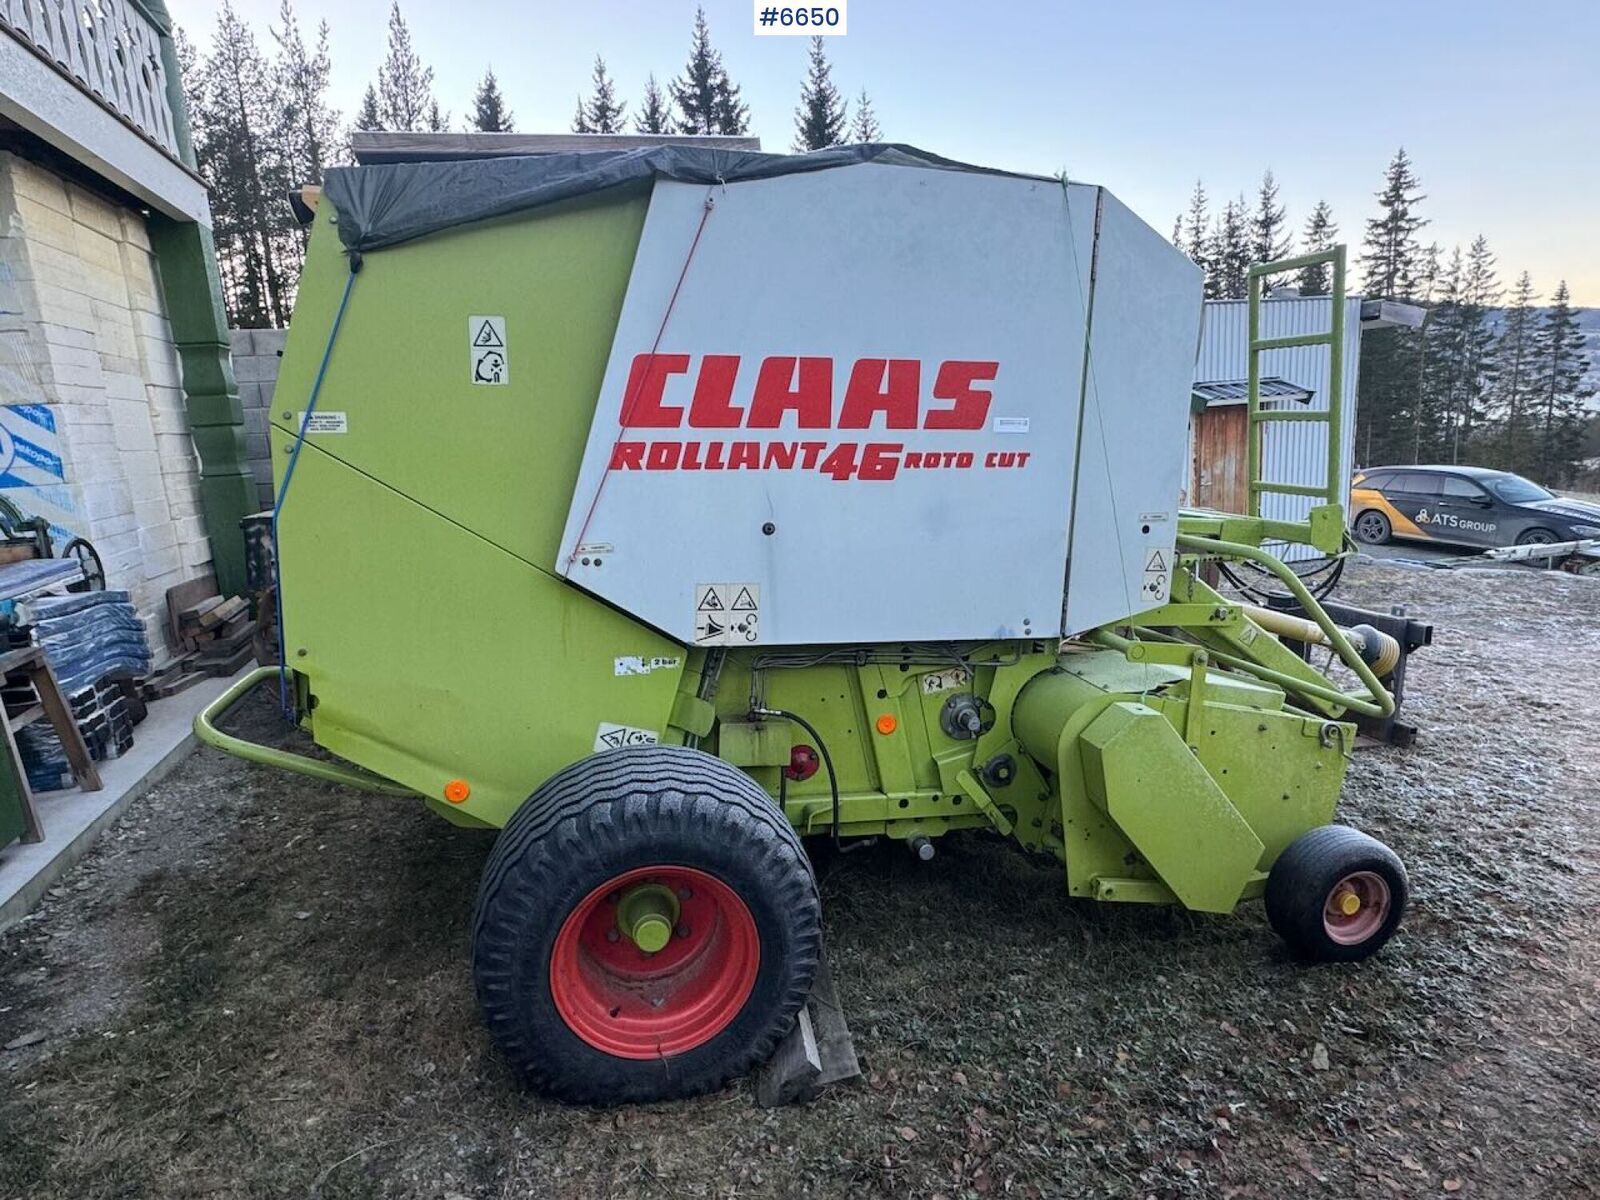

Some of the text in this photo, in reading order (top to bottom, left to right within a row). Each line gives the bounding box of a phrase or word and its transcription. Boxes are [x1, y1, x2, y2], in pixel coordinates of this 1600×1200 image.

[618, 353, 1000, 430] CLAAS
[608, 441, 1031, 481] ROLLANT 46 ROTO CUT
[1431, 513, 1497, 533] ATS GROUP
